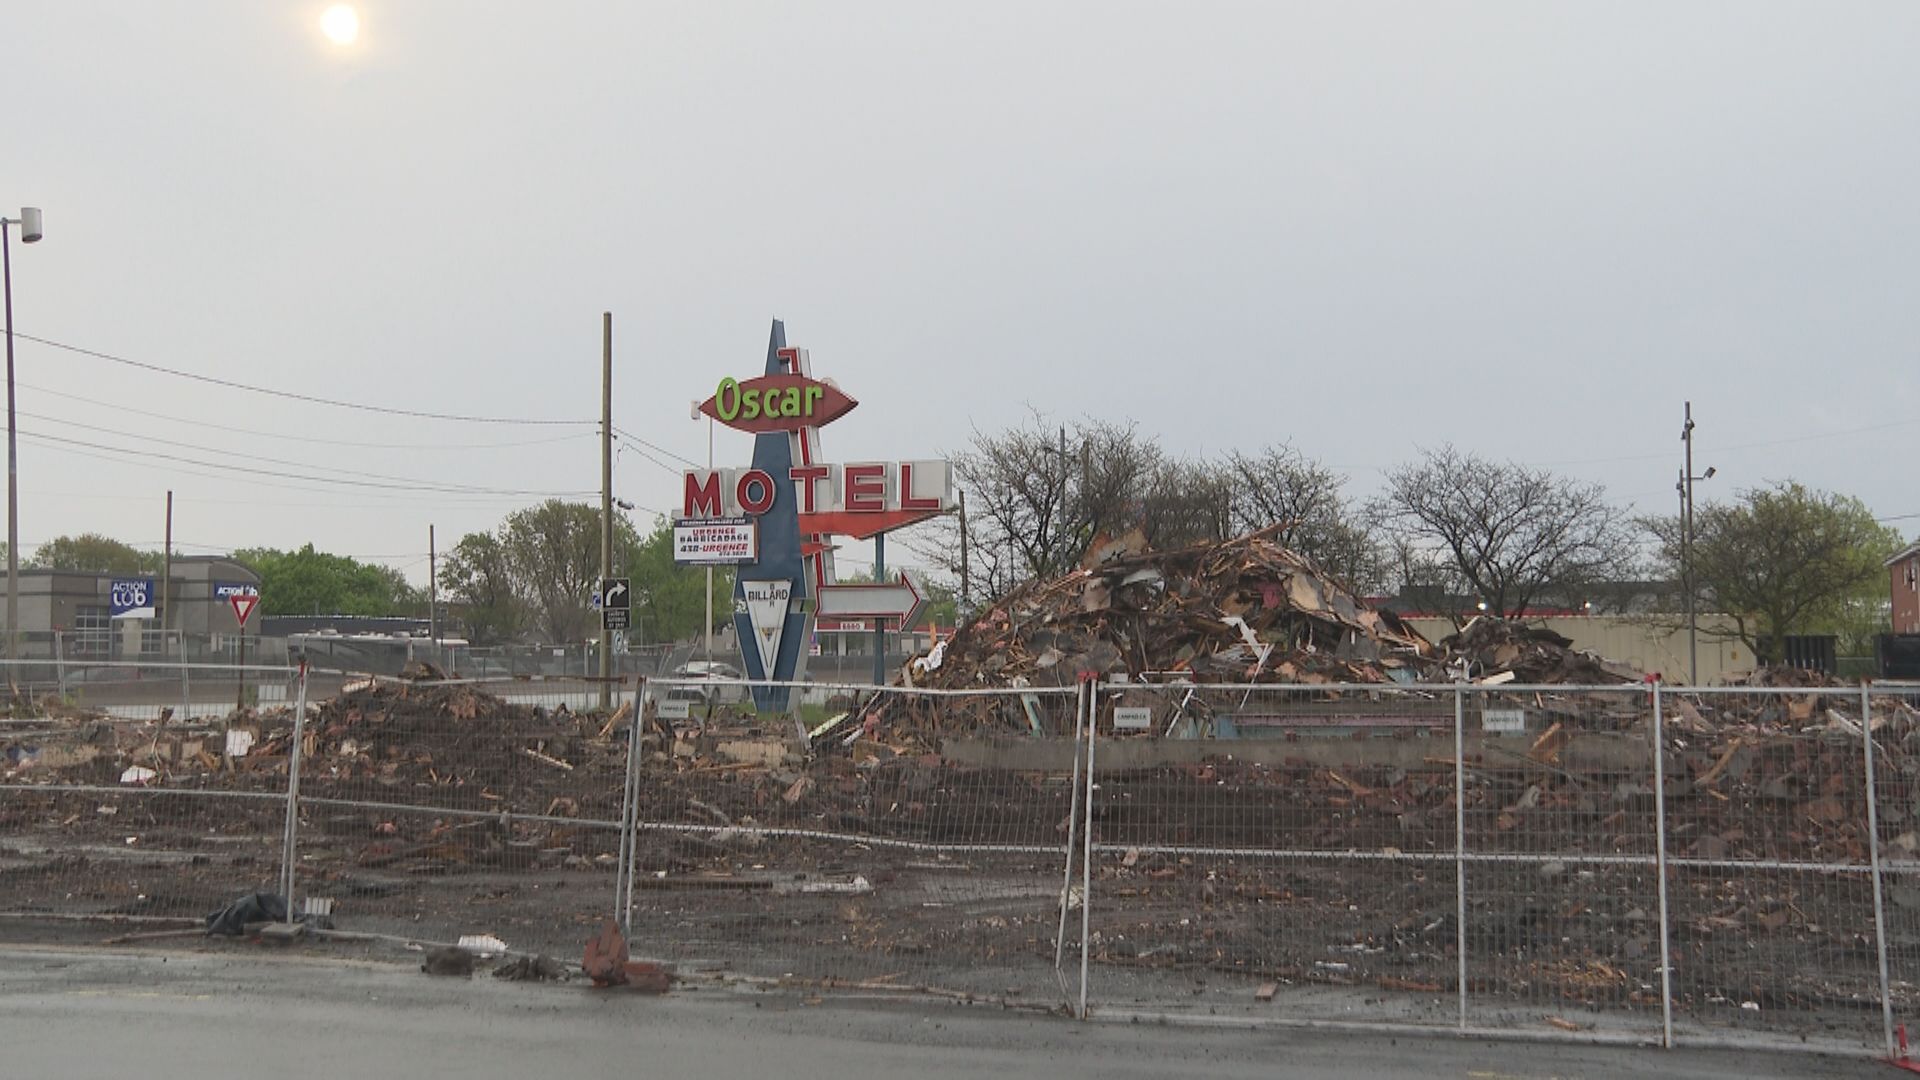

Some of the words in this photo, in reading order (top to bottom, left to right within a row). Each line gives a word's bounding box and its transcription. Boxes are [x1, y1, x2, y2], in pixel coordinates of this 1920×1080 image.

[715, 376, 823, 421] Oscar
[683, 463, 942, 518] MOTEL
[692, 527, 736, 536] URGENCE
[680, 533, 749, 543] BARRICADAGE
[112, 582, 148, 592] ACTION
[217, 586, 240, 596] ACTION
[748, 589, 789, 601] BILLARD
